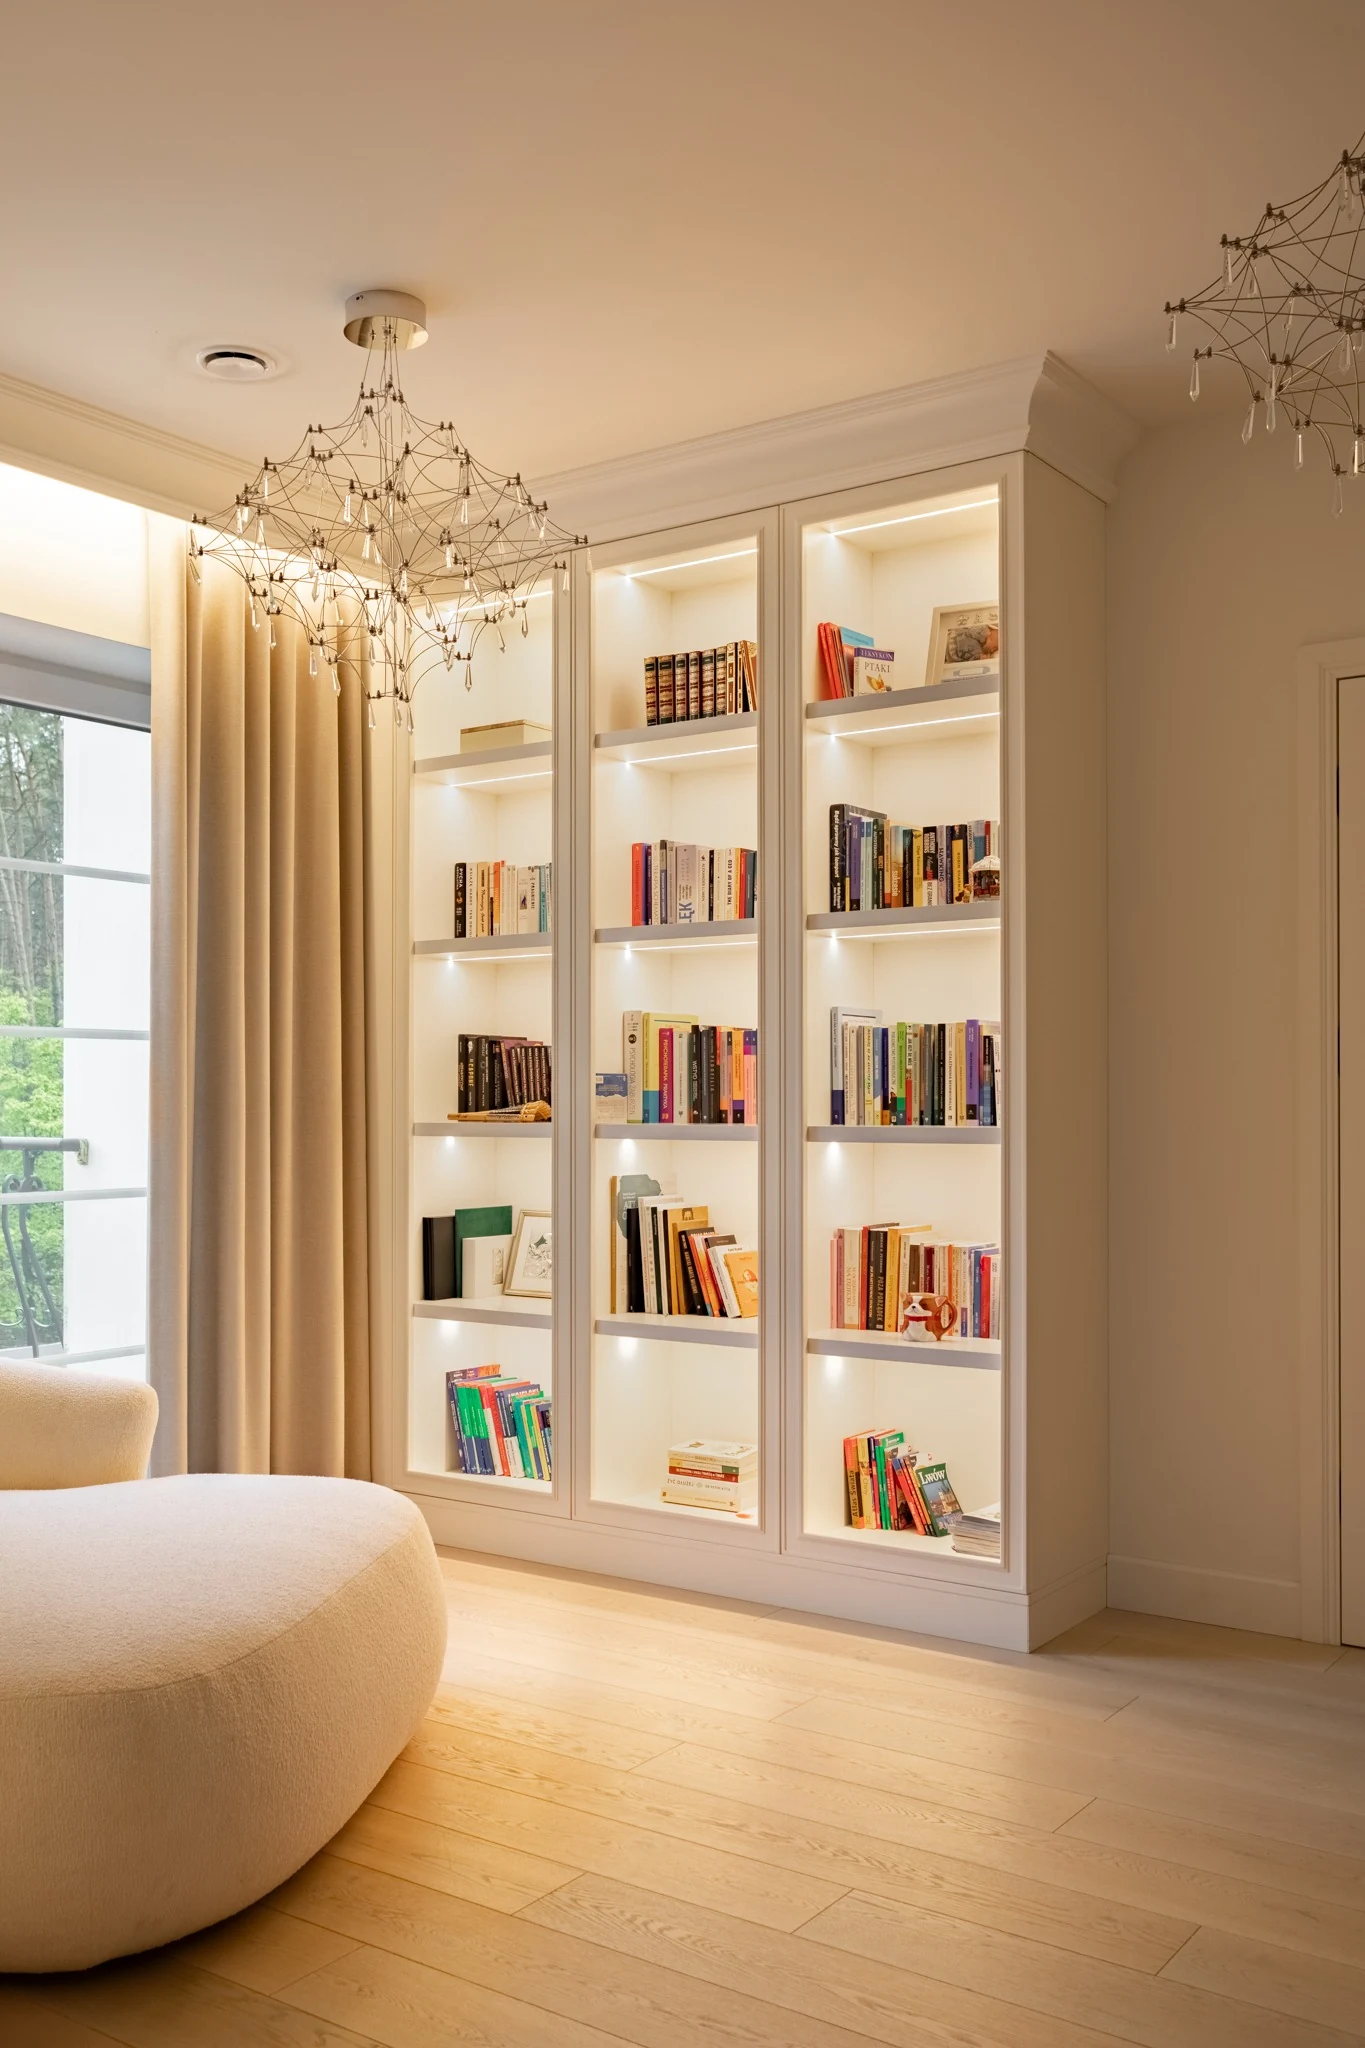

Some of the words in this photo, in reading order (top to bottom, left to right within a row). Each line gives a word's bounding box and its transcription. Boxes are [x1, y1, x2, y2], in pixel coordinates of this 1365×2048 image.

[864, 662, 890, 673] PTAKI
[892, 870, 900, 896] sukcesie
[846, 1267, 851, 1277] NA
[848, 1470, 857, 1498] Świata
[918, 1468, 946, 1486] Lwów
[851, 1499, 859, 1517] Atlas
